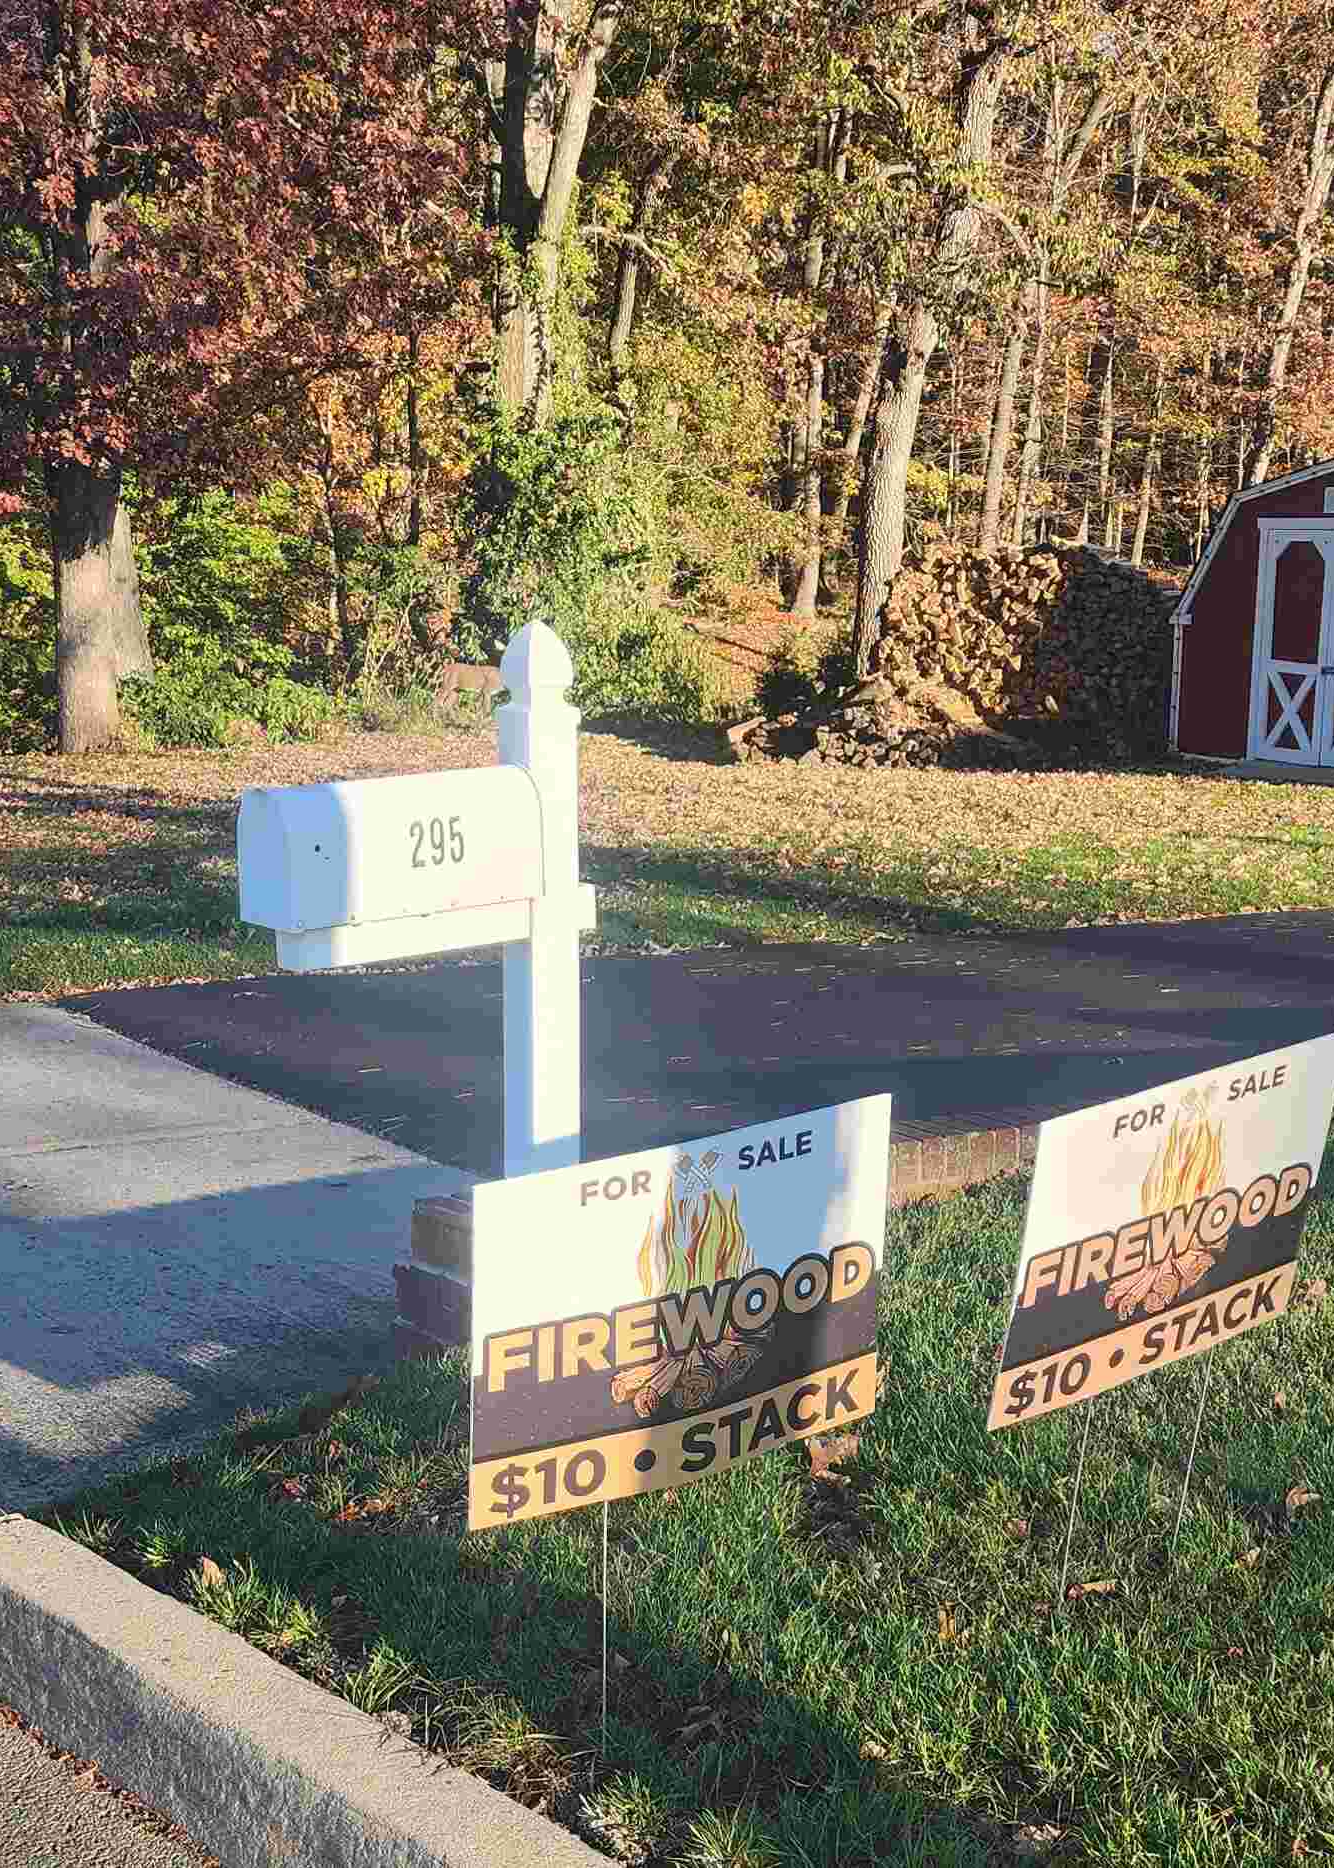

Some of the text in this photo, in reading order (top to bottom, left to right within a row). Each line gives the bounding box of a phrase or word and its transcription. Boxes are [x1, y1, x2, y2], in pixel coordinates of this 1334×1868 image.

[409, 815, 466, 869] 295
[580, 1130, 813, 1207] FOR SALE
[1113, 1064, 1287, 1139] FOR SALE
[1017, 1162, 1314, 1309] FIREWOOD
[482, 1240, 875, 1393] FIREWOOD
[1004, 1273, 1283, 1417] $10 STACK
[489, 1367, 860, 1518] $10 STACK
